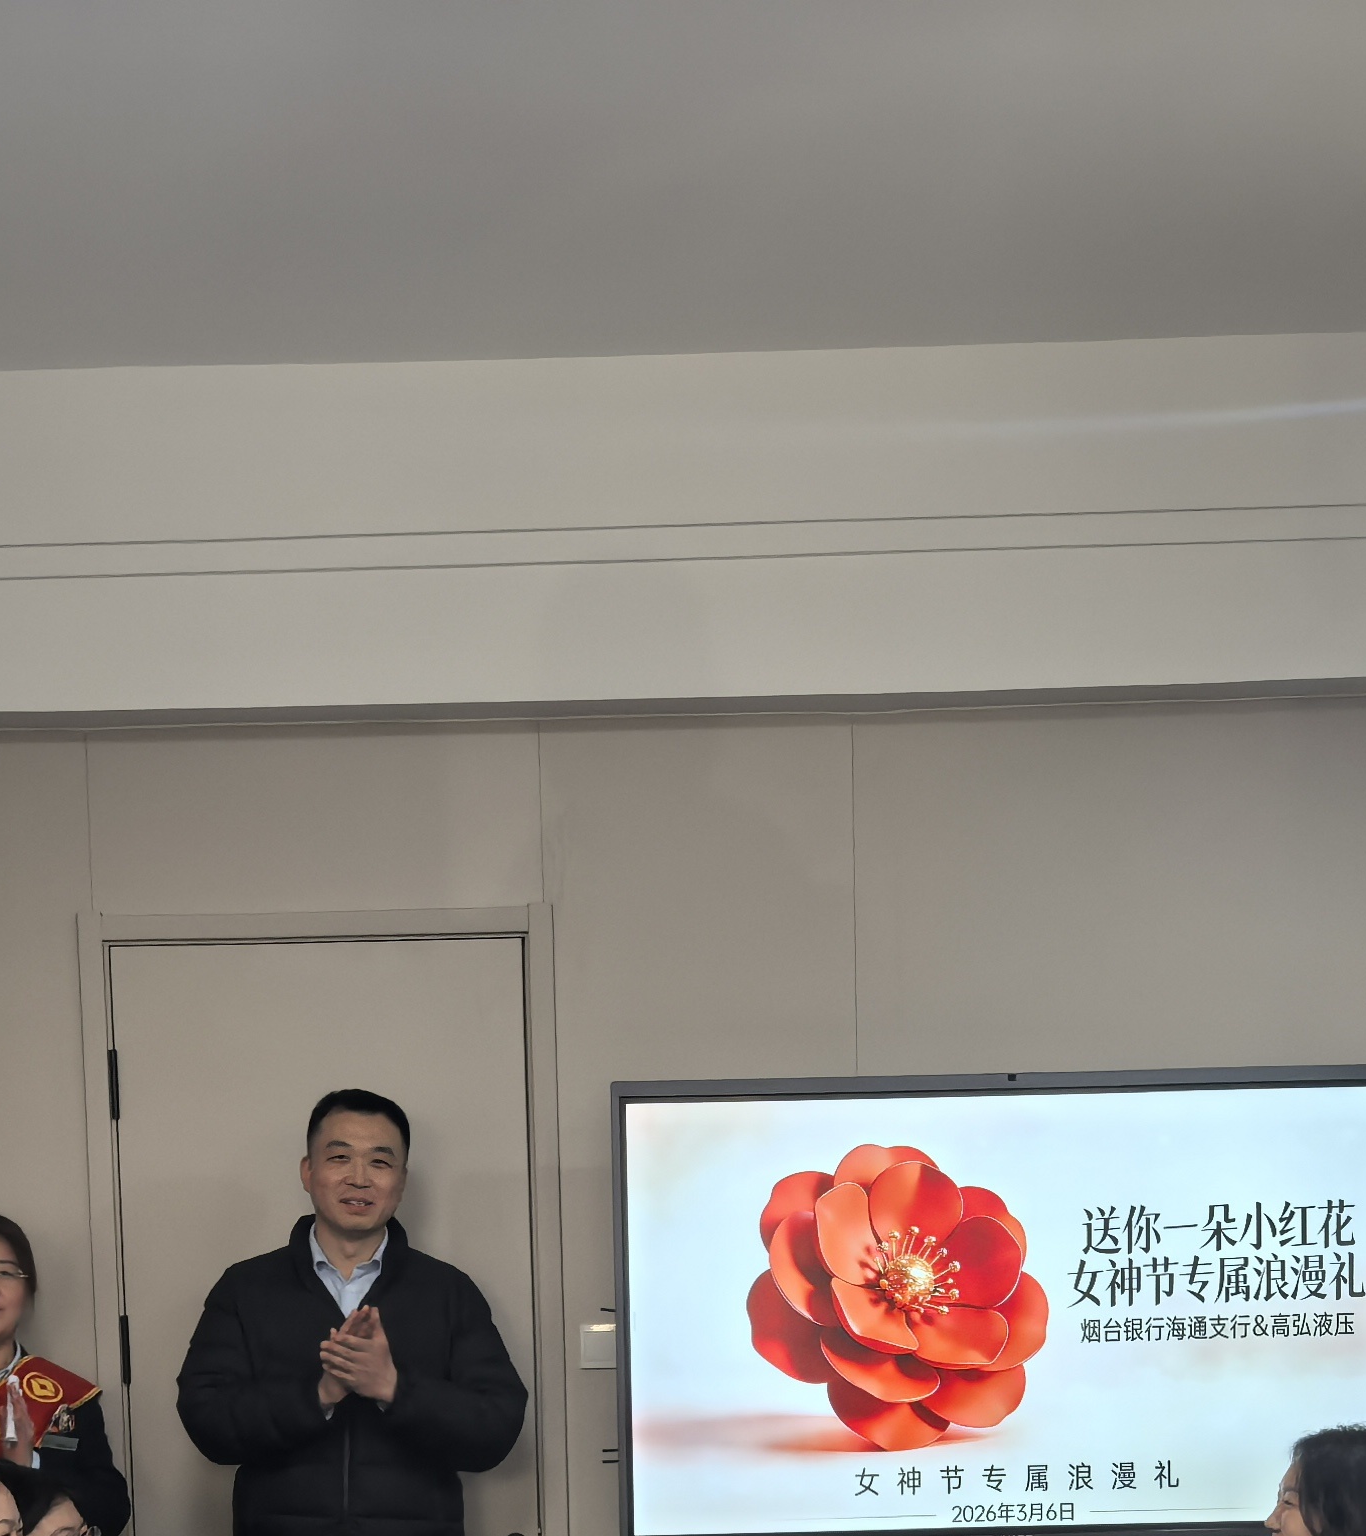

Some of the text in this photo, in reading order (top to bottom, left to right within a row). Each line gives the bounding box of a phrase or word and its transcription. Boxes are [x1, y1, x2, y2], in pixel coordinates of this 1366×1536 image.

[1082, 1198, 1356, 1255] 送你一朵小红花
[1067, 1252, 1366, 1308] 女神节专属浪漫礼
[1080, 1311, 1355, 1344] 烟台银行海通支行&高弘液压
[951, 1502, 1074, 1523] 2026年3月6日
